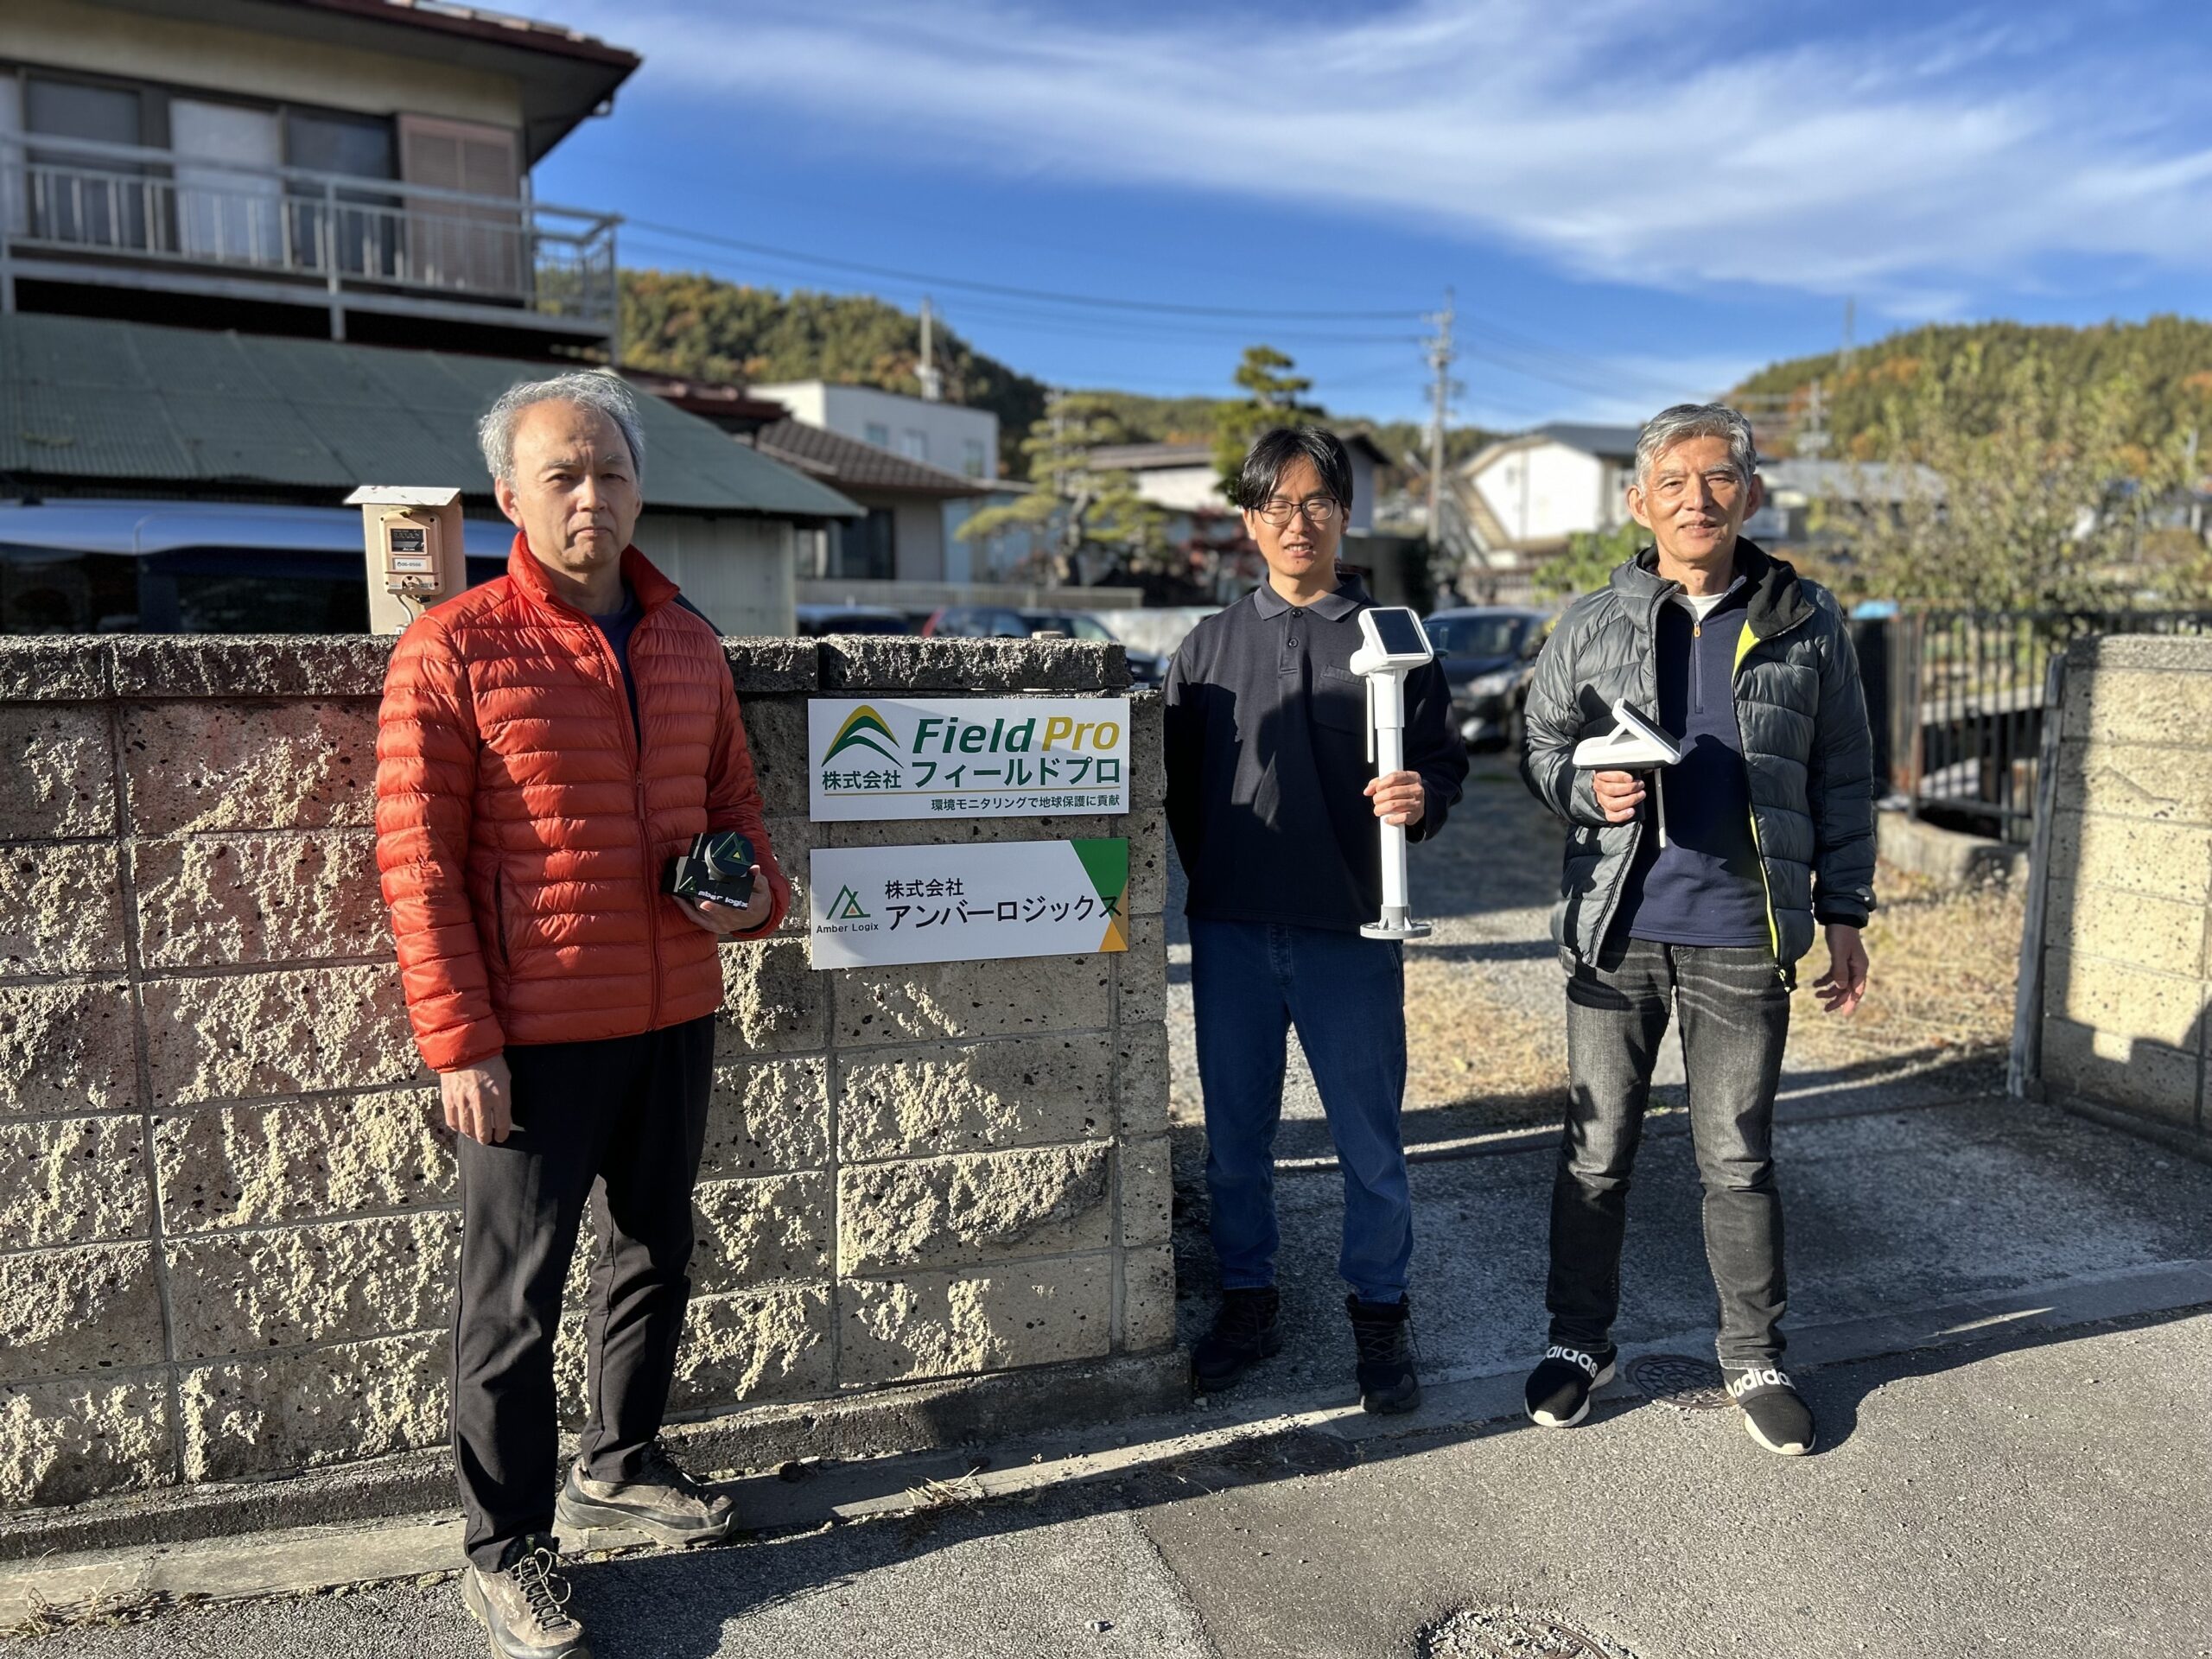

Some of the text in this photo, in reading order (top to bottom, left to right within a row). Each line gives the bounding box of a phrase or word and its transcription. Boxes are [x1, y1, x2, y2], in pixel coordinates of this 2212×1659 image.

[912, 716, 1121, 754] Field Pro
[822, 770, 902, 791] 株式会社
[912, 756, 1120, 788] フィールドプロ
[931, 794, 1120, 811] 環境モニタリングで地球保護に貢献
[885, 878, 964, 899] 株式会社
[885, 894, 1123, 931] アンバーロジックス
[817, 923, 879, 934] Amber Logix
[1542, 1345, 1598, 1378] didas
[1733, 1368, 1796, 1397] adida
